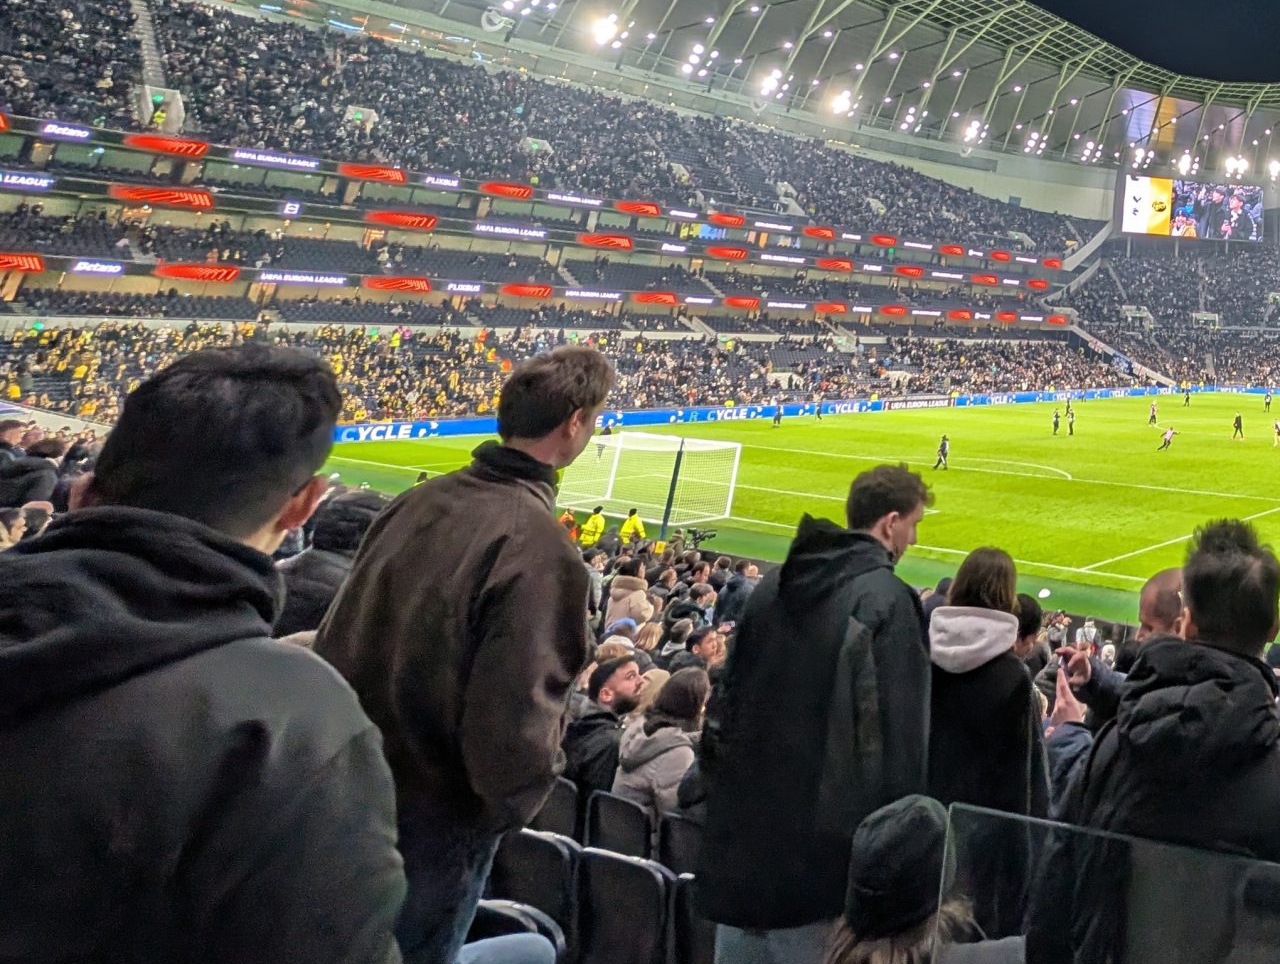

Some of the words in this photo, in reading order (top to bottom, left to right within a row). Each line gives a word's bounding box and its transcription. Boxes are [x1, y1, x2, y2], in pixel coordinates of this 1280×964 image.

[43, 124, 90, 138] Betano
[234, 150, 257, 160] UEFA
[257, 154, 286, 164] EUROPA
[287, 157, 317, 168] LEAGUE
[4, 174, 49, 187] LEAGUE
[425, 176, 459, 187] FLIXBUS
[73, 261, 122, 273] Betano
[260, 271, 282, 280] UEFA
[283, 274, 313, 282] EUROPA
[314, 276, 344, 284] LEAGUE
[341, 424, 413, 442] CYCLE
